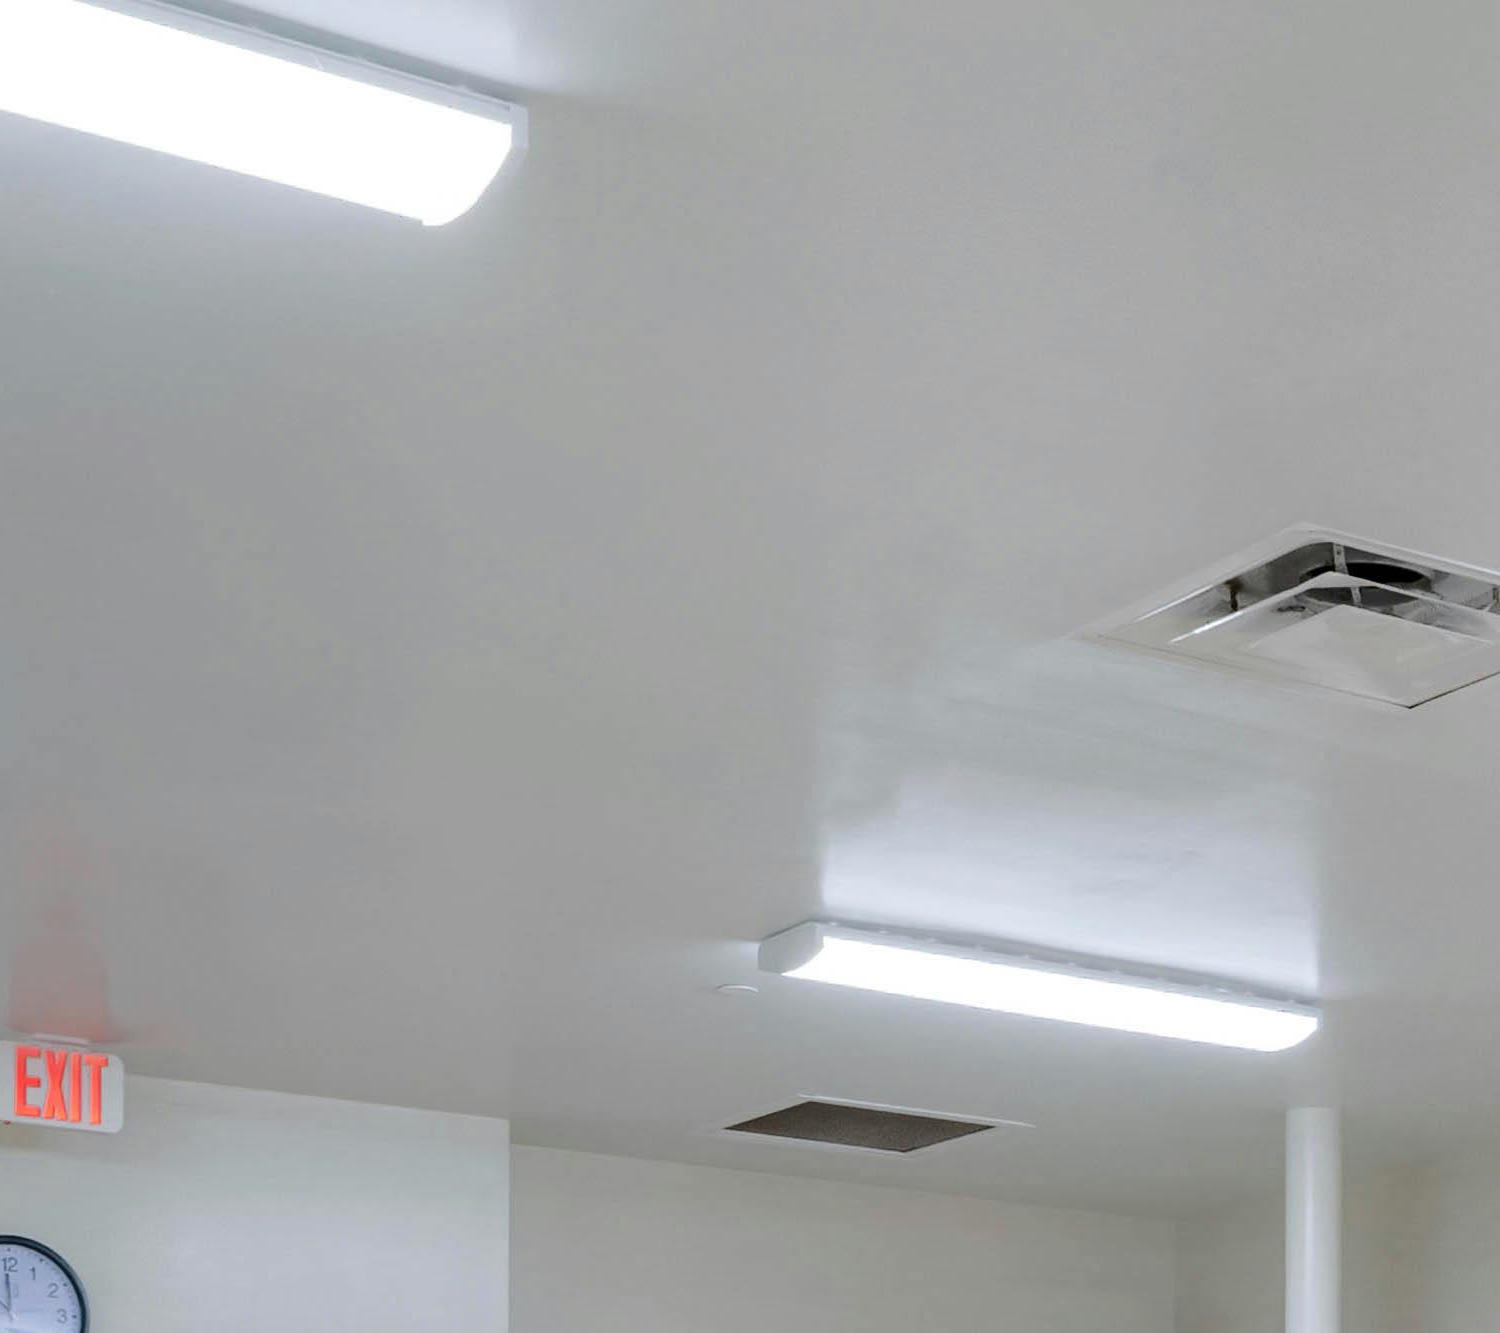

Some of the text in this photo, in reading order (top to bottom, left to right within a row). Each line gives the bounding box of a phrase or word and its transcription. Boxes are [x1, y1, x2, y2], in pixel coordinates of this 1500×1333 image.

[13, 1044, 109, 1126] EXIT
[2, 1257, 18, 1273] 12
[29, 1267, 36, 1281] 1
[47, 1283, 59, 1299] 2
[57, 1308, 68, 1324] 3
